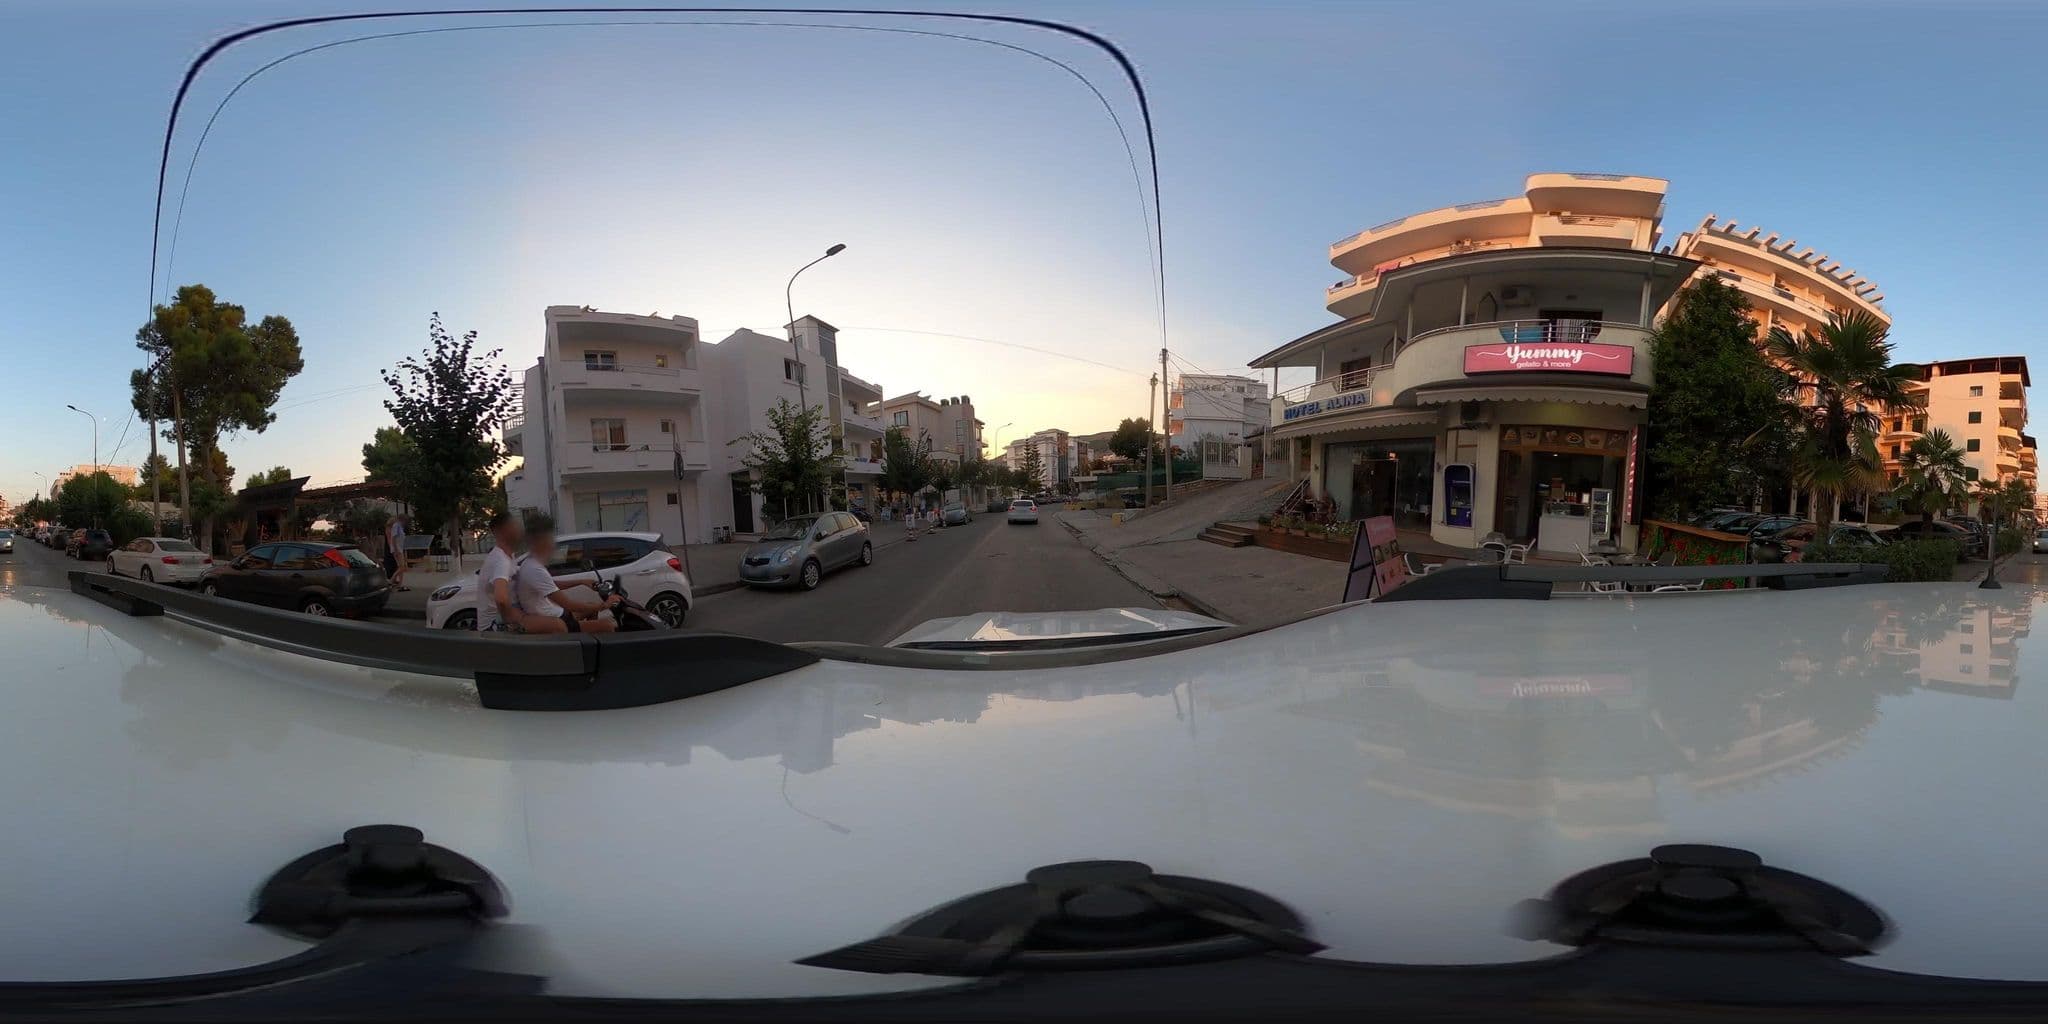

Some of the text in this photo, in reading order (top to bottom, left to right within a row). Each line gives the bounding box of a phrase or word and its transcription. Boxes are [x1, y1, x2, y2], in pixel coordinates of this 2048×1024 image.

[1506, 345, 1583, 364] Yummy
[1516, 360, 1541, 369] gelato
[1326, 393, 1365, 410] ALINA
